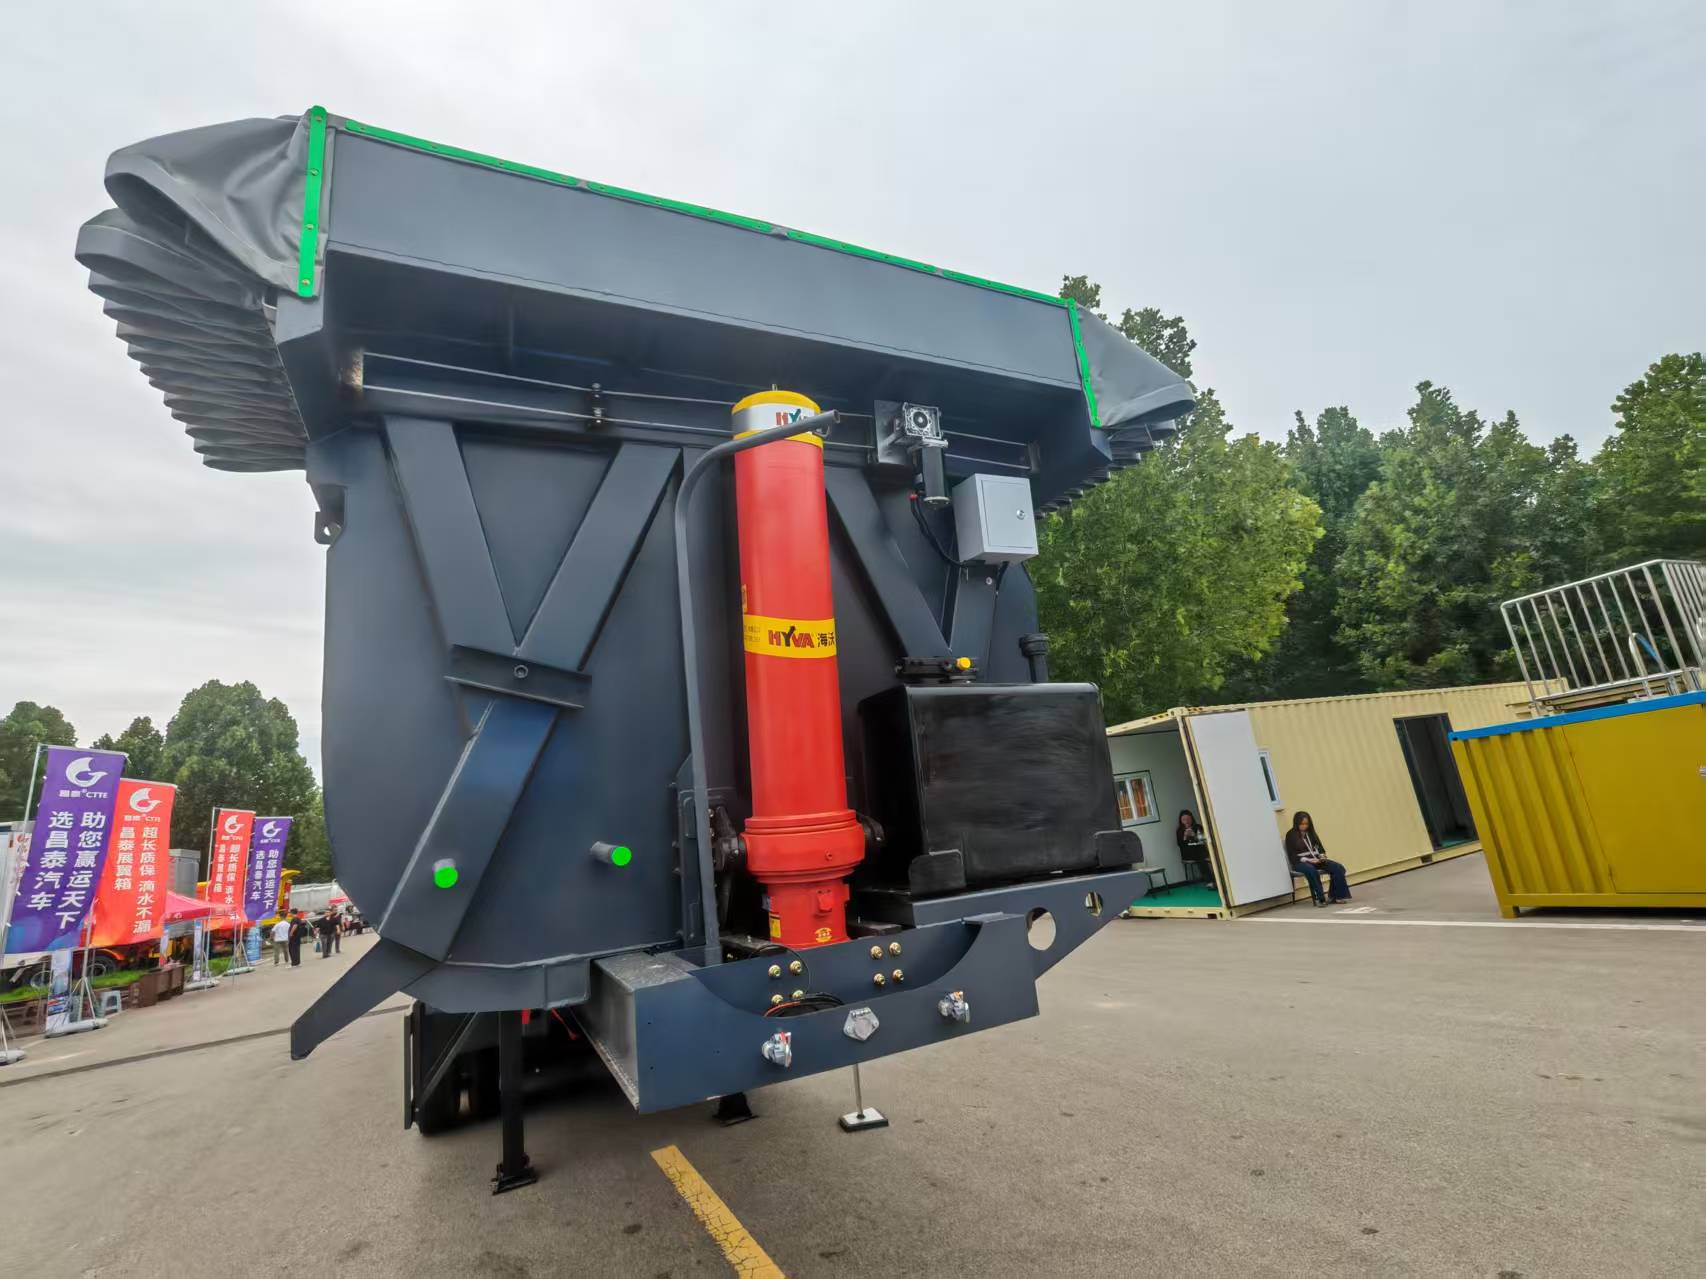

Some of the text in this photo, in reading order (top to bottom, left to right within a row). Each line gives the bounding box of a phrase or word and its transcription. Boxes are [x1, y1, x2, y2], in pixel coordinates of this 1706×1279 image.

[768, 626, 814, 648] HYVA
[86, 791, 108, 799] CTTE
[26, 811, 74, 911] 选昌泰汽车
[55, 811, 106, 930] 助您赢运天下
